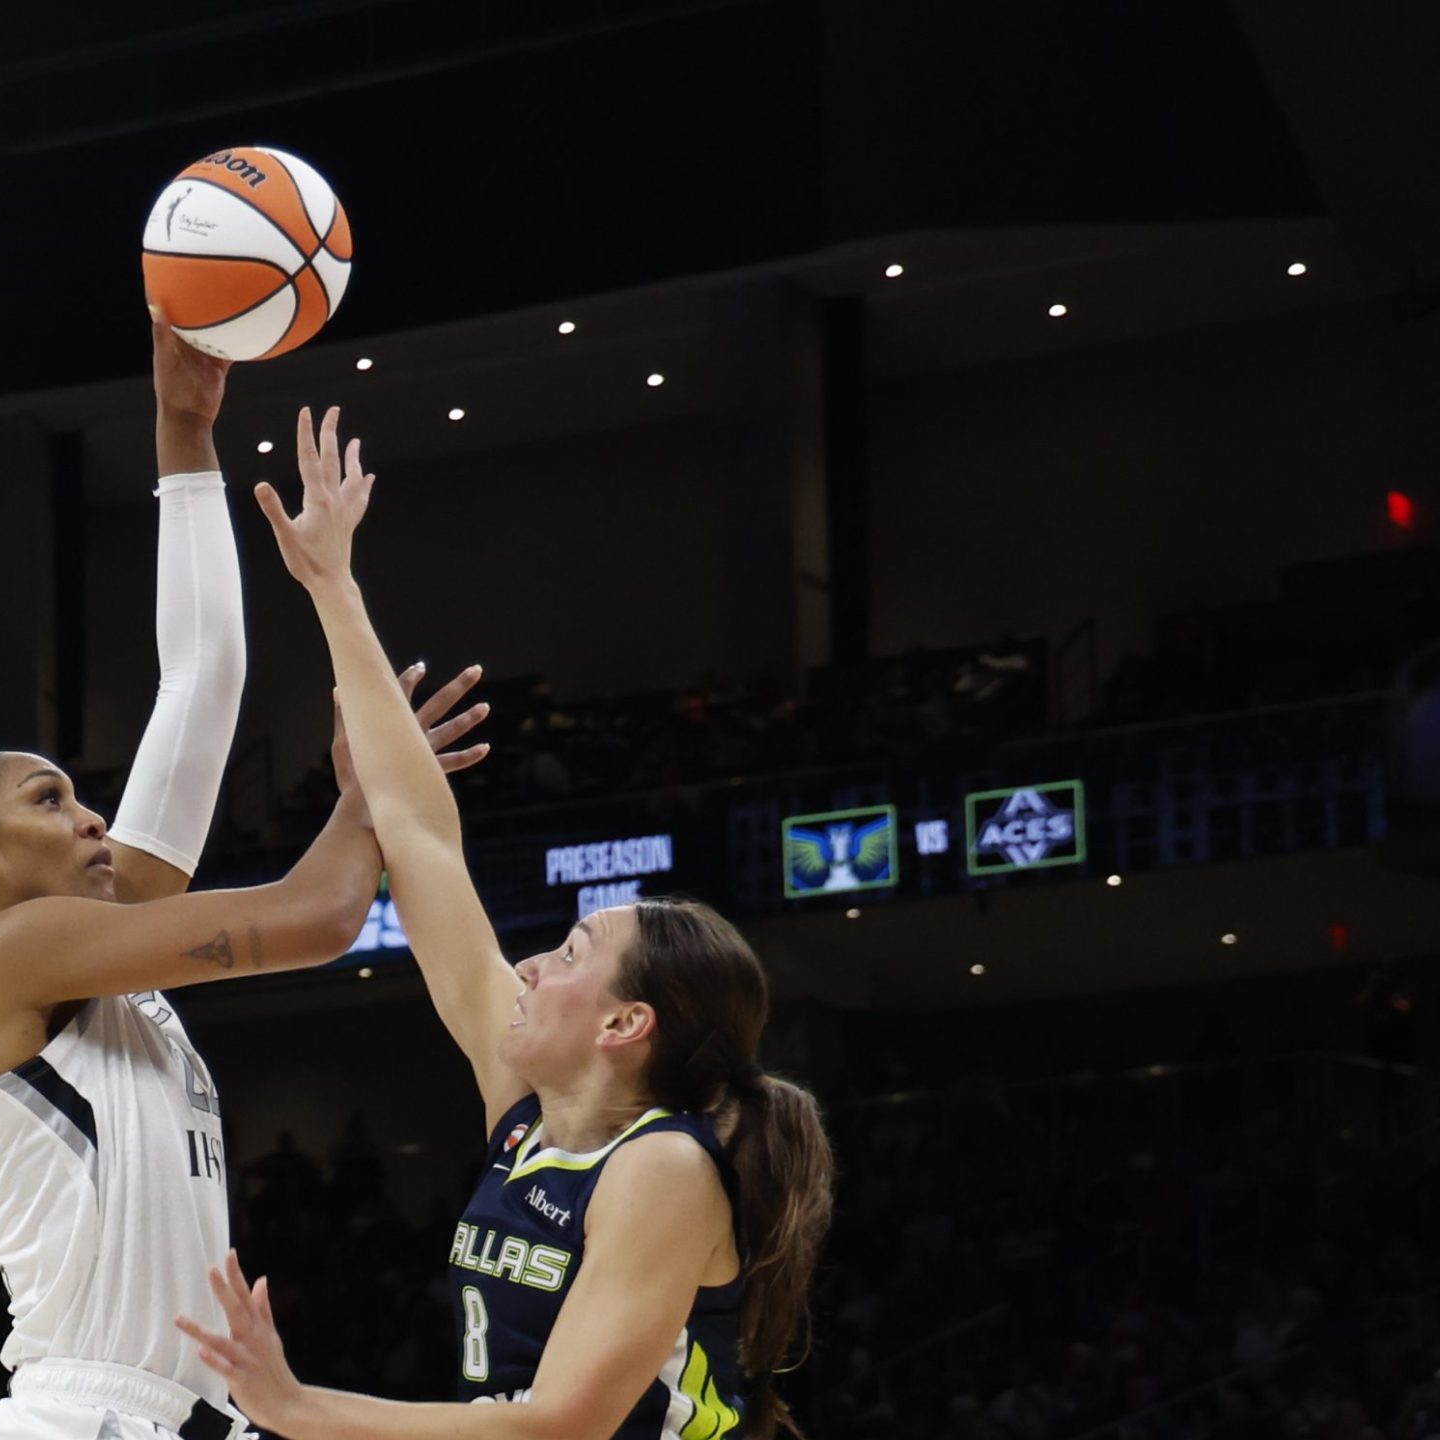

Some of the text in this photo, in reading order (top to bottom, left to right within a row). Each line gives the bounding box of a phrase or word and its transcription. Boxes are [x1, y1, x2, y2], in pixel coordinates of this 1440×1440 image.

[979, 814, 1073, 849] ACES
[545, 834, 672, 886] PRESEASON
[524, 1184, 572, 1228] Albert
[462, 1285, 489, 1383] 8
